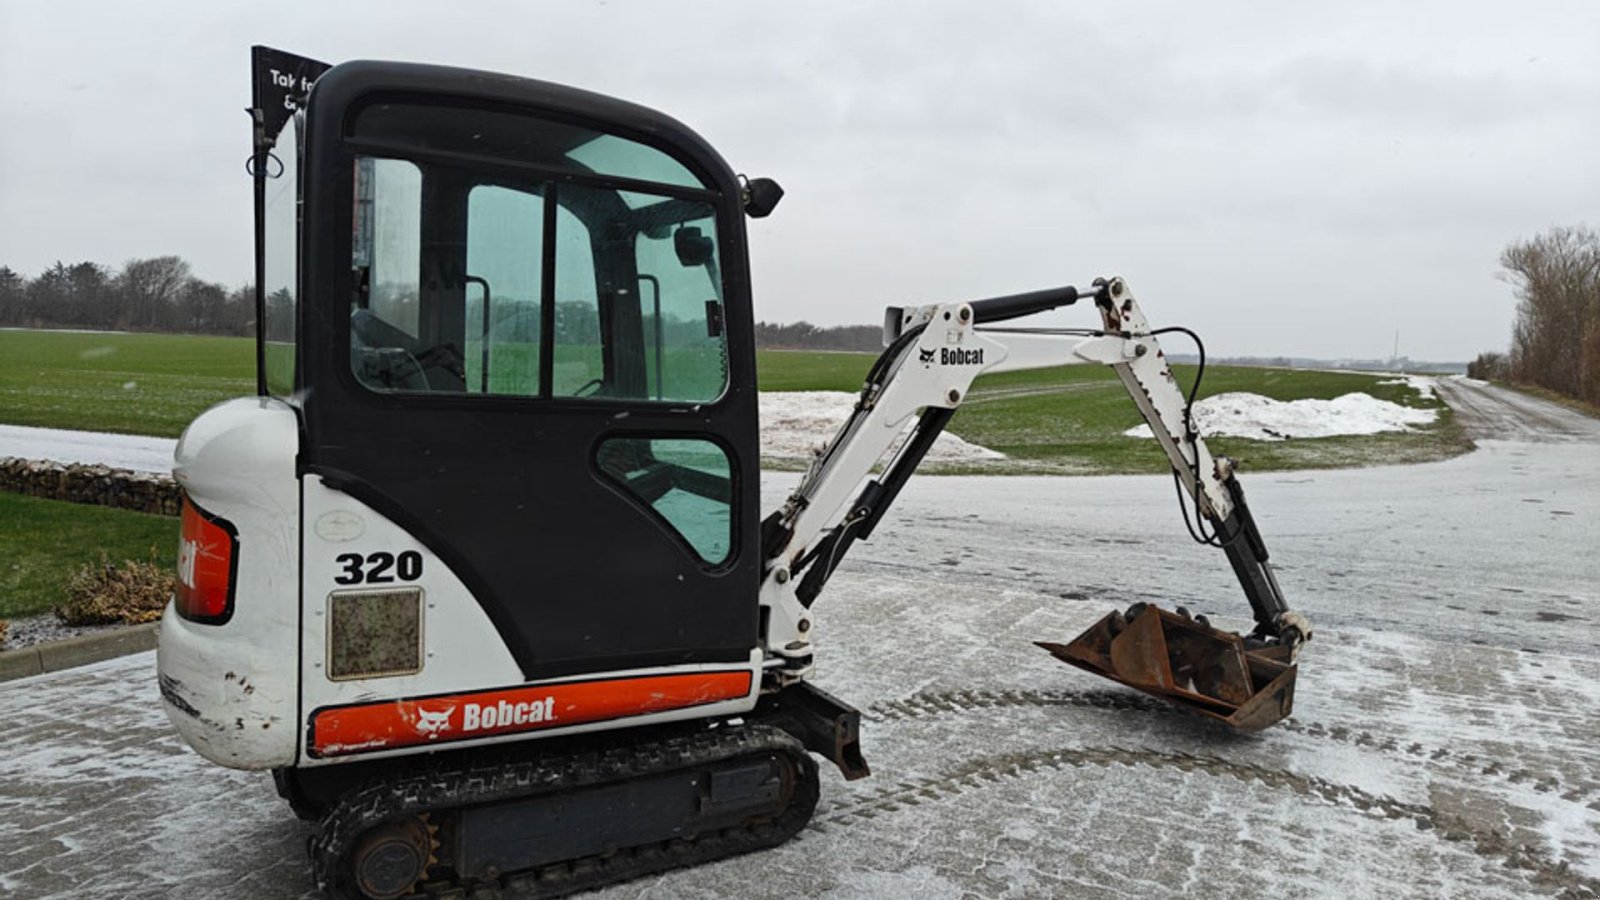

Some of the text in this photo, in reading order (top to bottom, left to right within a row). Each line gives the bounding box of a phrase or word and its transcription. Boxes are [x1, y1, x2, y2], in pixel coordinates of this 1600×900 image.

[941, 347, 984, 366] Bobcat
[334, 550, 423, 585] 320
[463, 696, 556, 731] Bobcat
